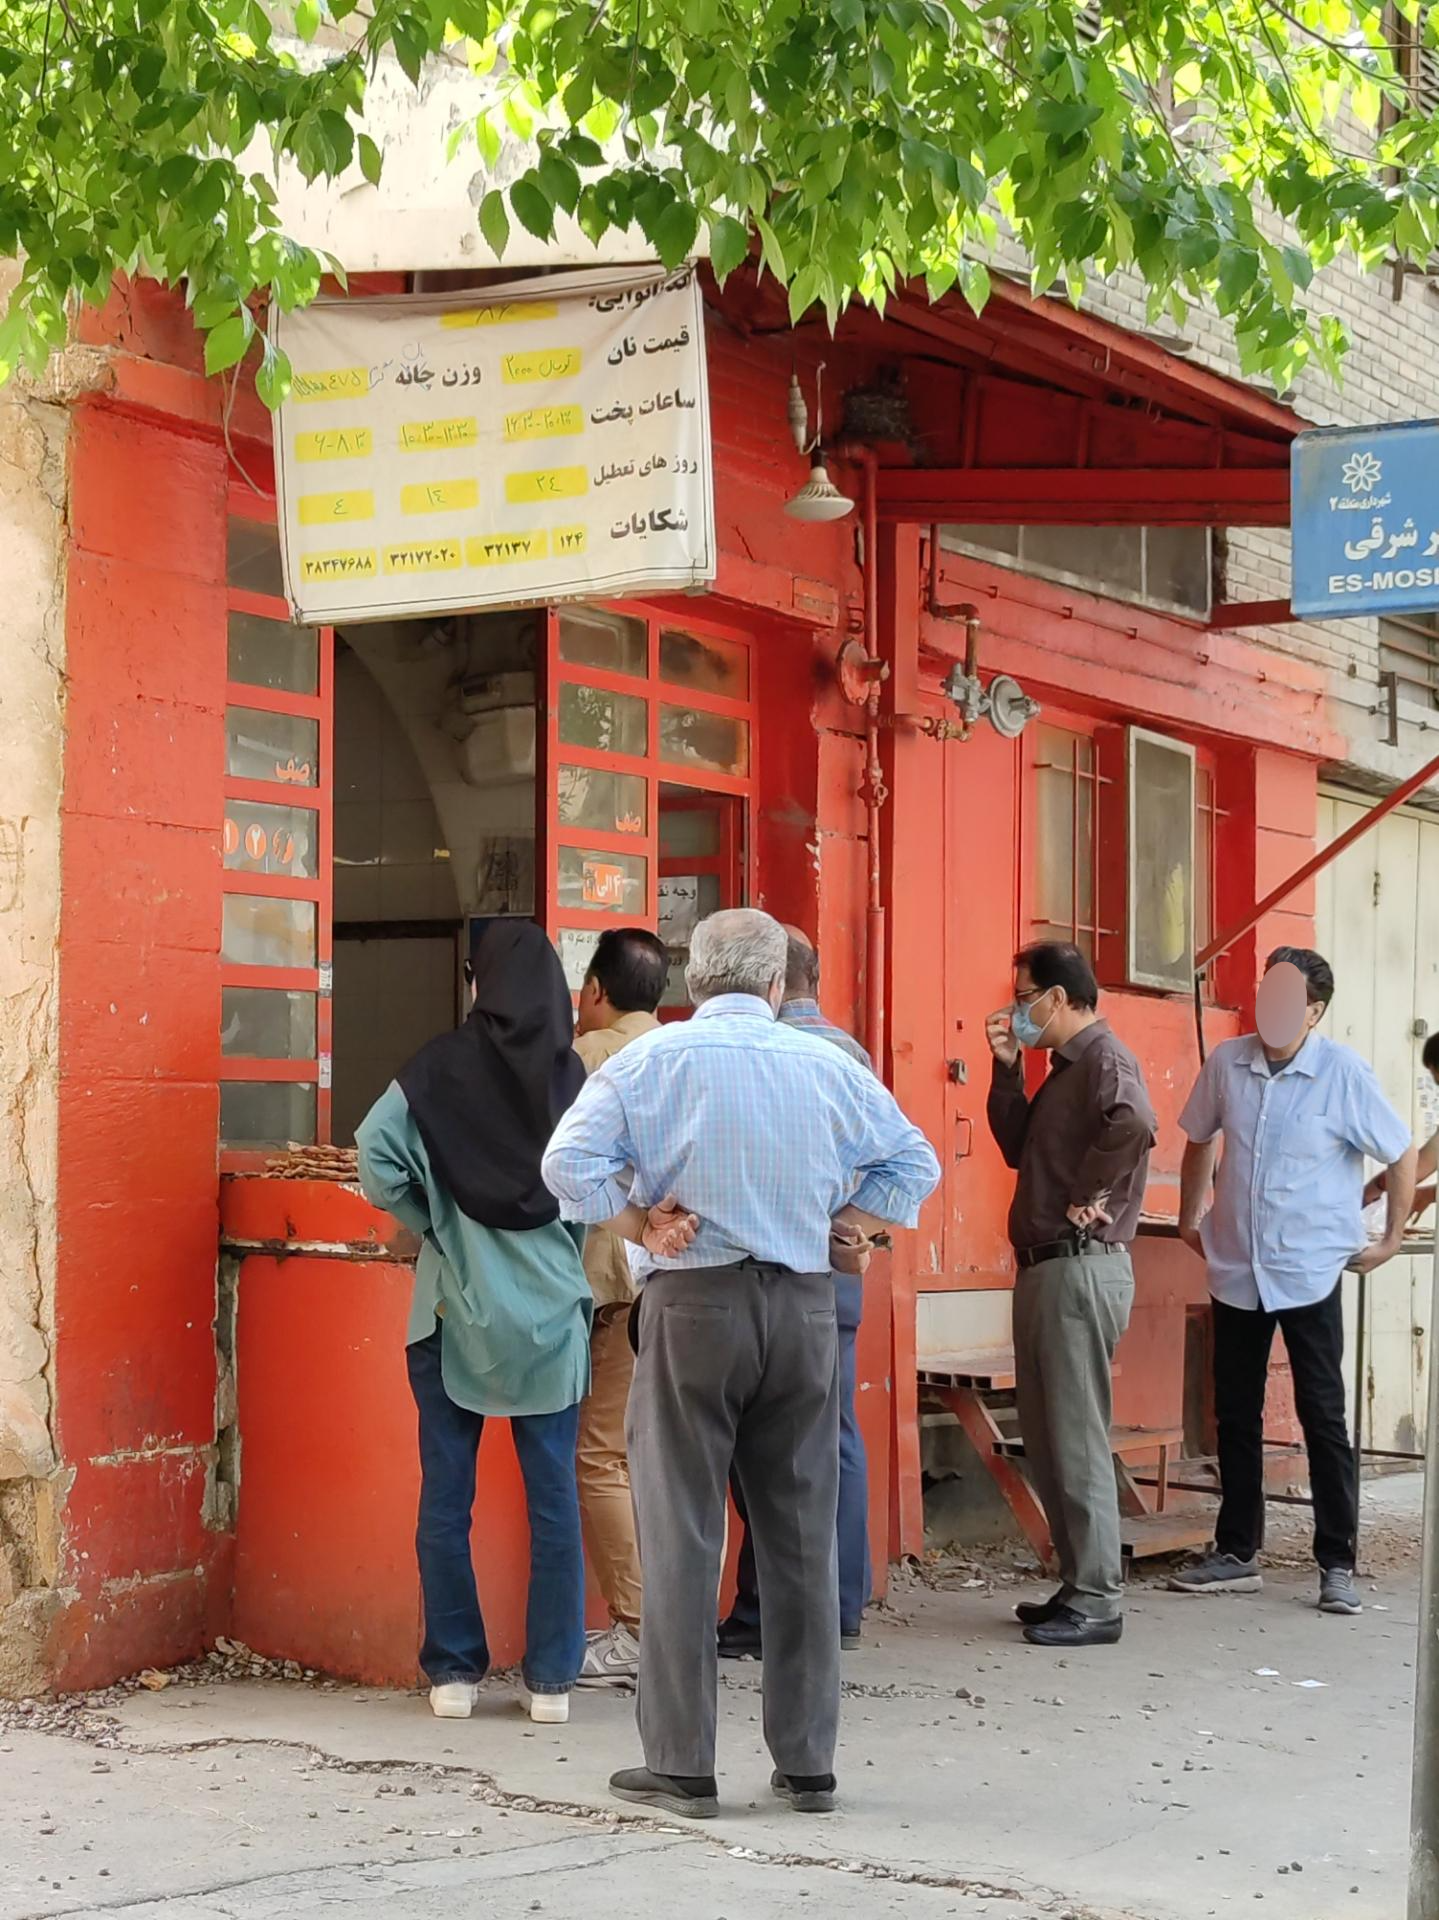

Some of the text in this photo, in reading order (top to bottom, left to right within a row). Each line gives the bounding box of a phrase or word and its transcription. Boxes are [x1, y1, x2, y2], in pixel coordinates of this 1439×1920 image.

[607, 325, 690, 366] قیمت نان
[395, 363, 481, 391] وزن چانه
[590, 388, 696, 426] ساعات پخت
[593, 453, 698, 486] روز های تعطیل
[610, 507, 689, 540] شکایات
[1344, 516, 1419, 561] شرقی
[483, 540, 531, 558] ۳۲۱۳۷
[560, 531, 584, 549] ۱۲۴
[275, 756, 310, 780] صف
[615, 811, 642, 832] صف
